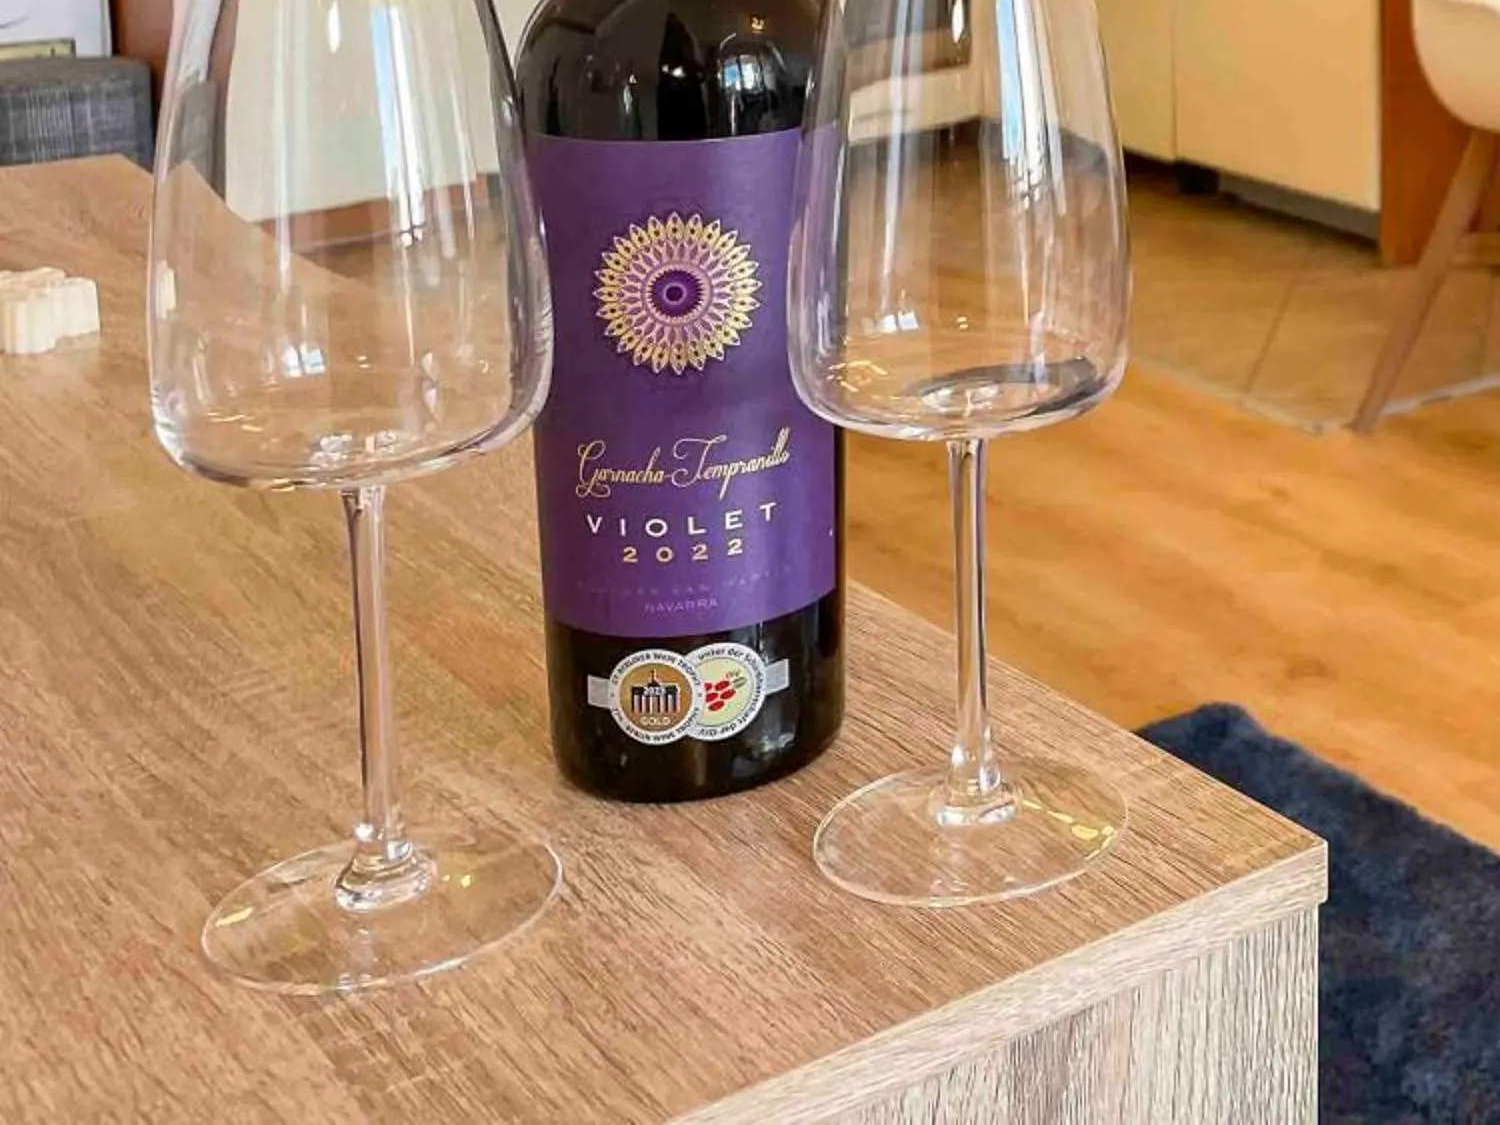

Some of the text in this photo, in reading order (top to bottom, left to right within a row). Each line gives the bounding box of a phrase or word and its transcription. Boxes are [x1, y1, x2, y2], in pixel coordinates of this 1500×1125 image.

[587, 502, 776, 537] VIOLET
[623, 538, 743, 563] 2022
[640, 716, 671, 726] GOLD
